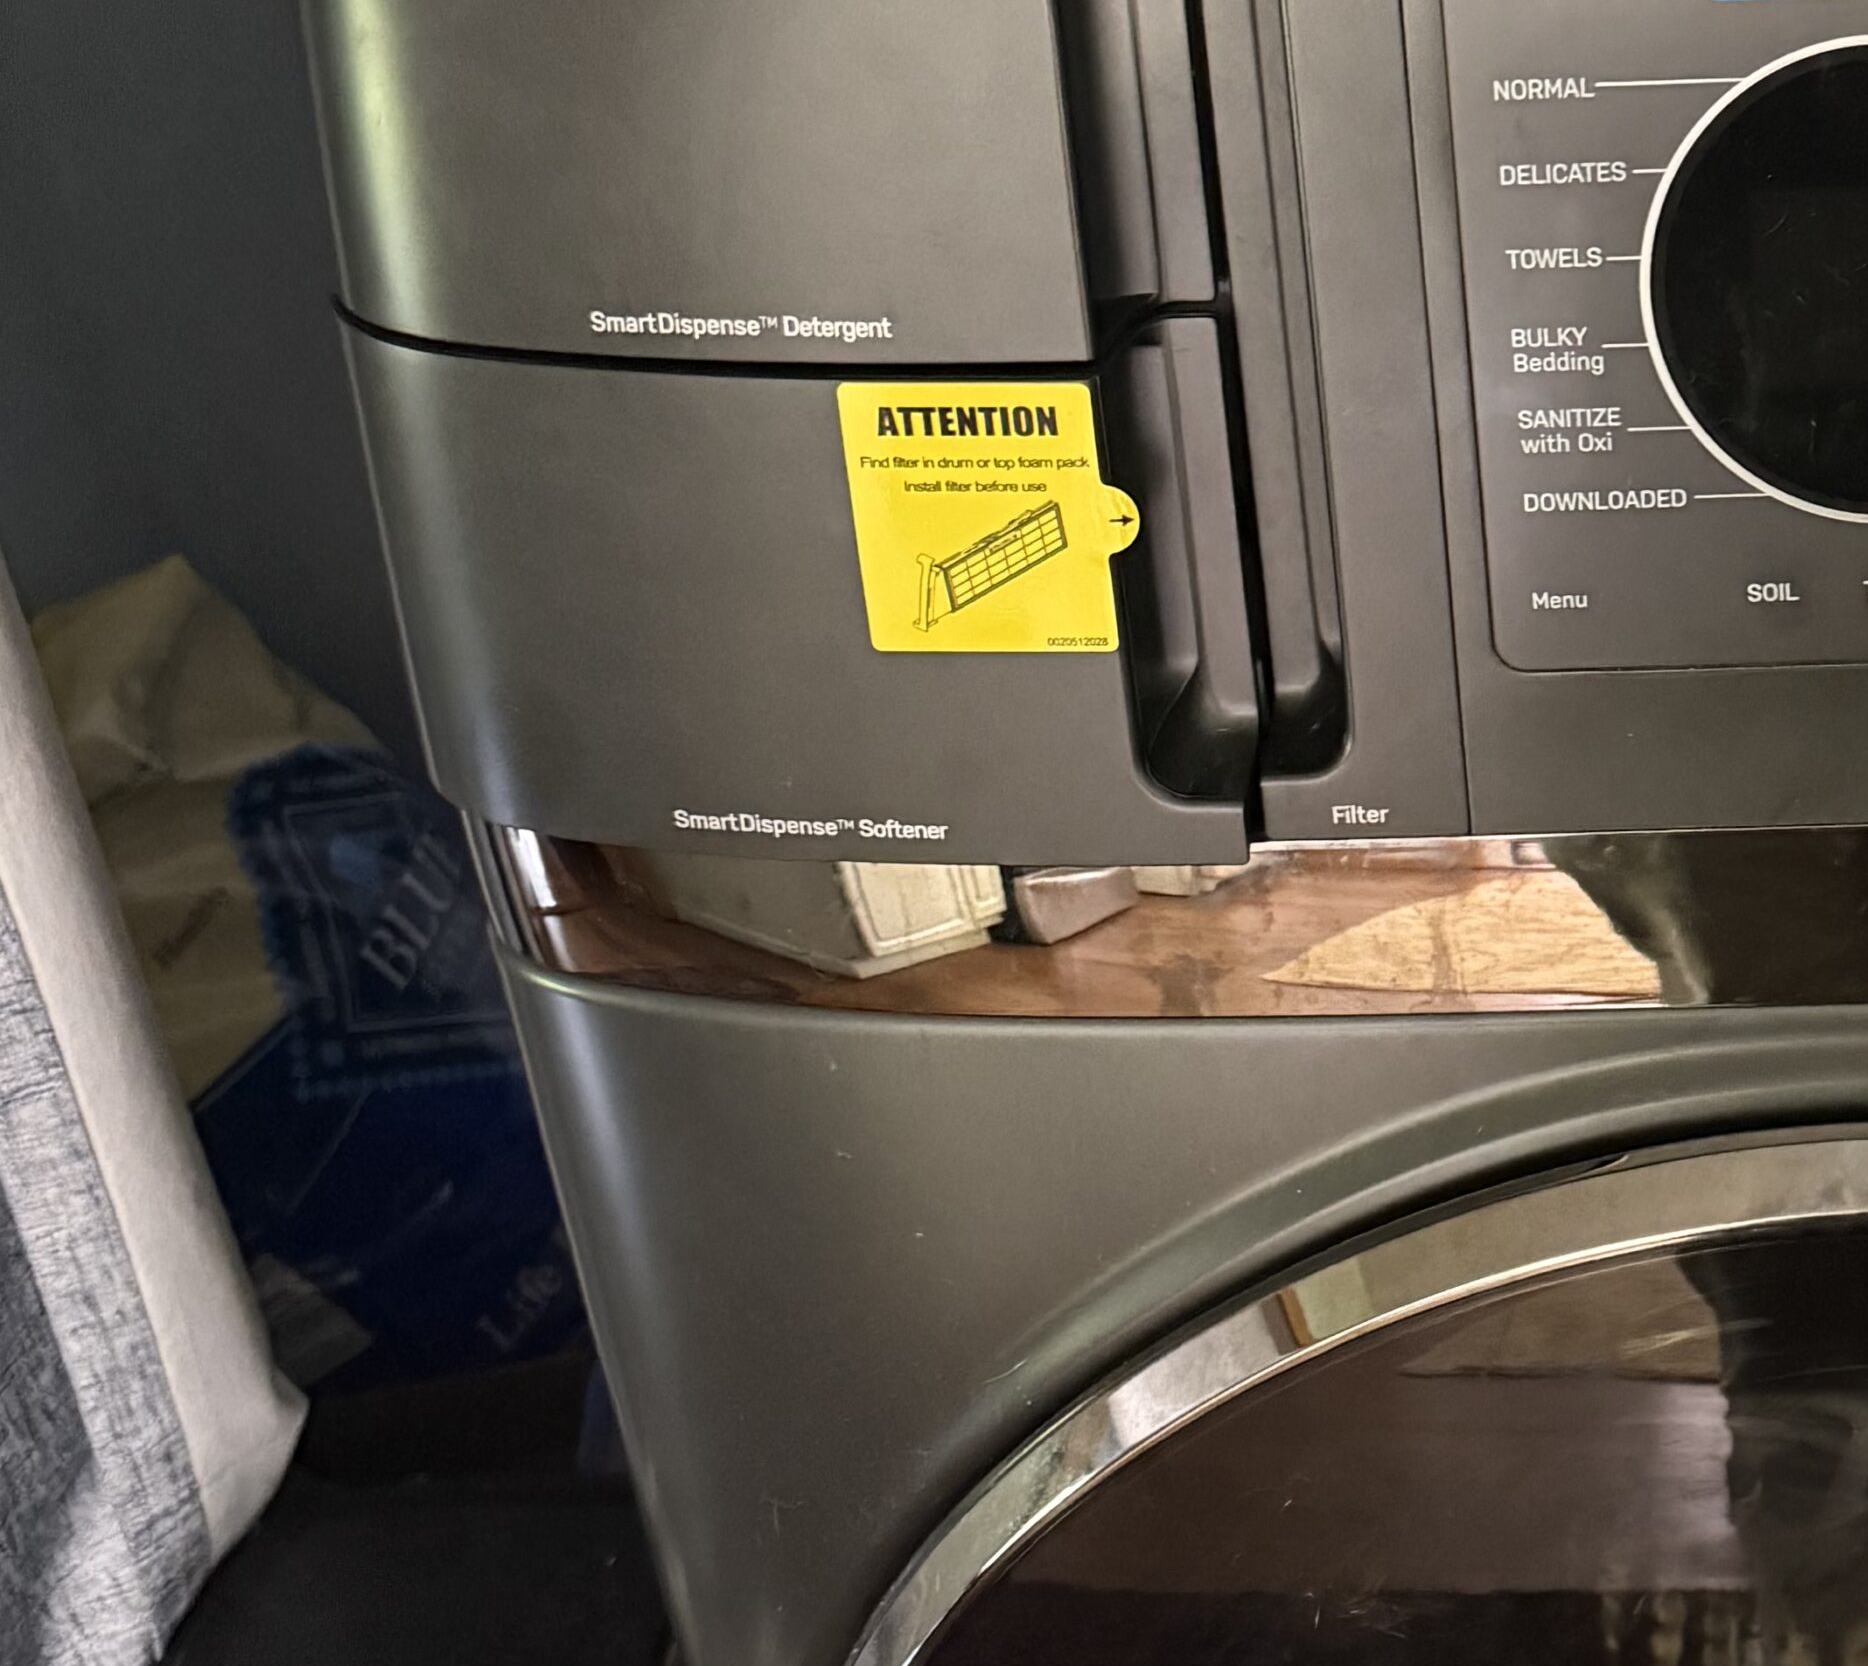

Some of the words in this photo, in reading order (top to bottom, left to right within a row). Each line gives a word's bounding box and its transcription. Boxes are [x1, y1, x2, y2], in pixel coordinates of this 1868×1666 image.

[1492, 77, 1597, 102] NORMAL
[1499, 161, 1628, 187] DELICATES
[1504, 246, 1604, 270] TOWELS
[782, 314, 893, 343] Detergent
[1510, 326, 1588, 349] BULKY
[1513, 351, 1605, 375] Bedding
[877, 405, 1060, 438] ATTENTION
[1517, 406, 1623, 430] SANITIZE
[1520, 434, 1571, 454] with
[1577, 431, 1613, 452] Oxi
[859, 456, 890, 469] Find
[892, 456, 920, 469] filter
[922, 456, 935, 468] in
[937, 456, 975, 469] drum
[976, 458, 991, 469] or
[993, 457, 1016, 472] top
[1018, 456, 1054, 468] foam
[903, 480, 943, 493] Install
[944, 480, 973, 493] filter
[975, 479, 1020, 493] before
[1022, 482, 1048, 493] use
[1523, 488, 1688, 513] DOWNLOADED
[1531, 591, 1588, 610] Menu
[1746, 582, 1800, 603] SOIL
[1331, 803, 1391, 826] Filter
[858, 818, 948, 840] Softener
